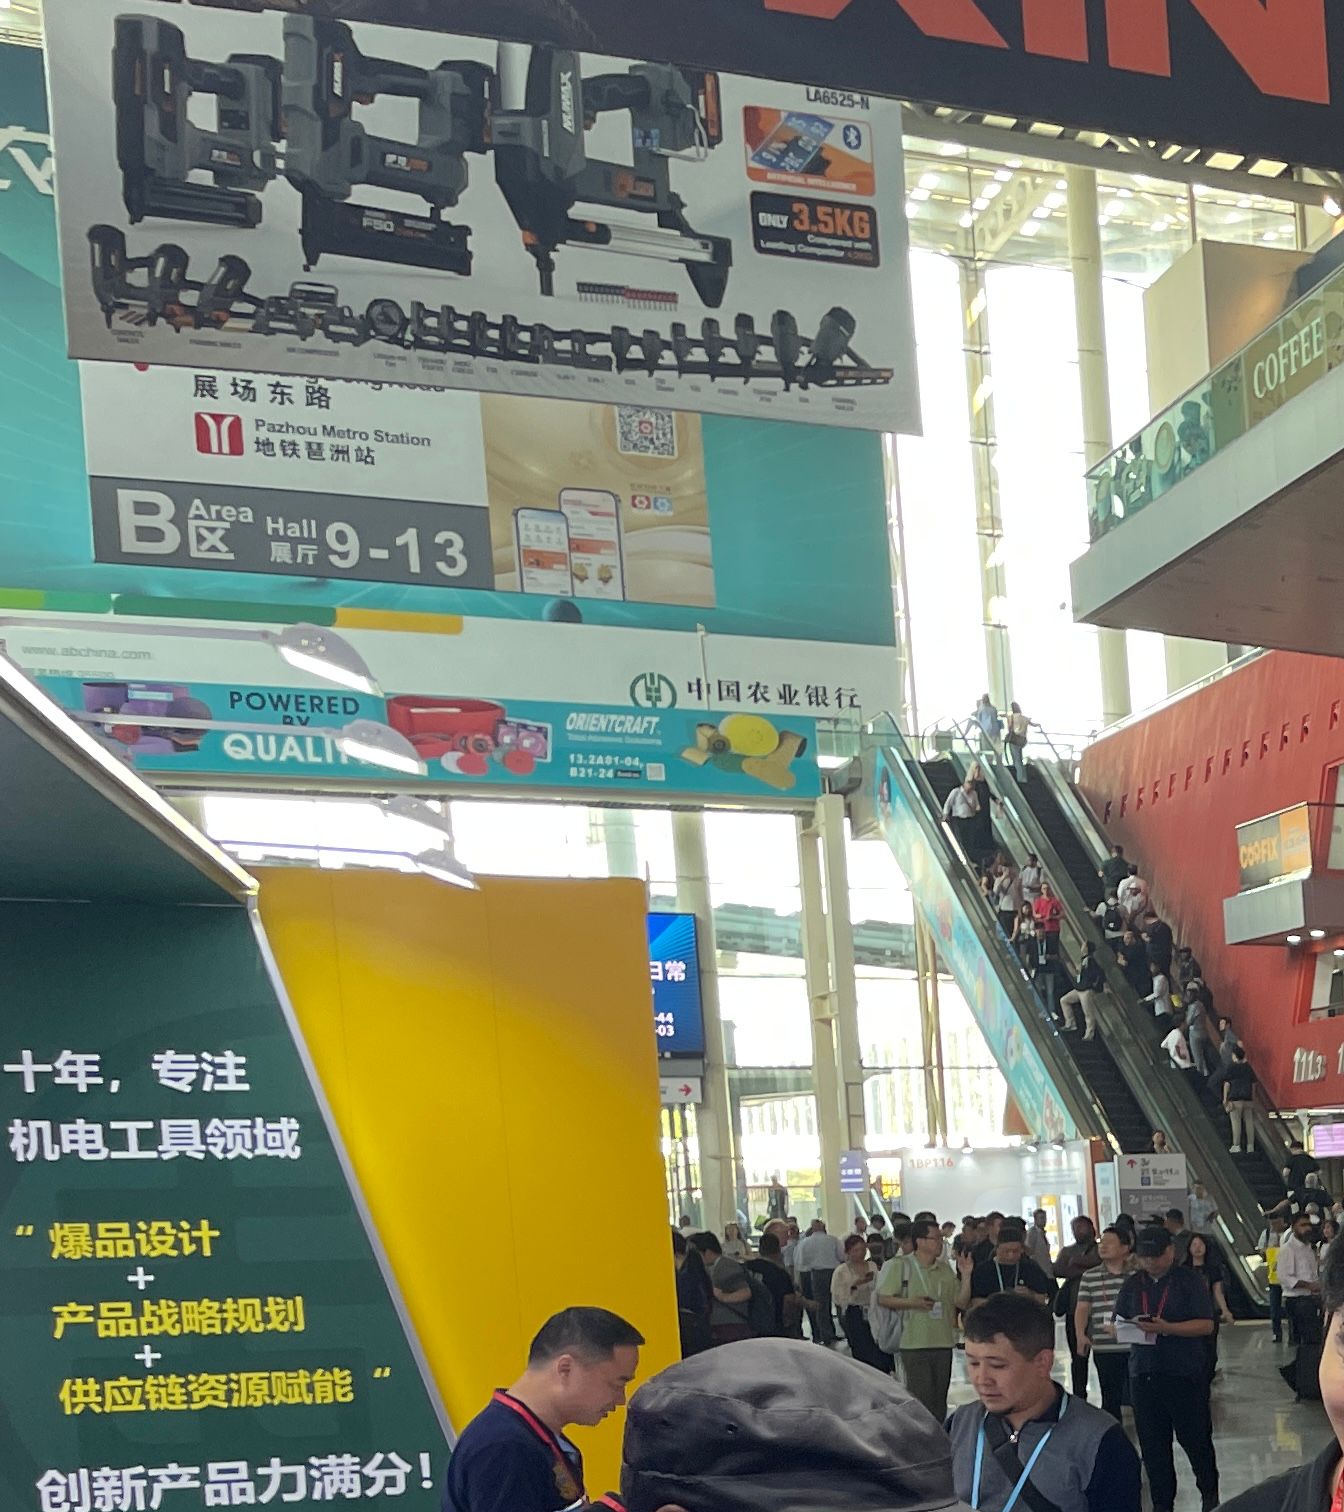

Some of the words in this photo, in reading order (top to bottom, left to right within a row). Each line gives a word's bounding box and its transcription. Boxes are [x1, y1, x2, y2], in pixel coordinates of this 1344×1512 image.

[806, 87, 870, 110] LA6525-N
[759, 212, 789, 228] ONLY
[791, 203, 871, 238] 3.5KG
[1253, 317, 1323, 399] COFFEE
[193, 375, 331, 410] 展场东路
[254, 419, 318, 439] Pazhou
[322, 423, 370, 443] Metro
[373, 428, 432, 448] Station
[254, 437, 376, 466] 地铁琶洲站
[116, 488, 181, 555] B
[188, 498, 254, 525] Area
[266, 516, 317, 540] Hall
[326, 521, 468, 578] 9-13
[189, 520, 235, 560] 区
[269, 542, 318, 567] 展厅
[229, 691, 359, 715] POWERED
[687, 677, 862, 708] 中国农业银行
[566, 712, 660, 735] ORIENTCRAFT
[8, 1116, 302, 1164] 机电工具领域
[49, 1219, 221, 1261] 爆品设计
[51, 1295, 306, 1340] 产品战略规划
[58, 1365, 355, 1415] 供应链资源赋能
